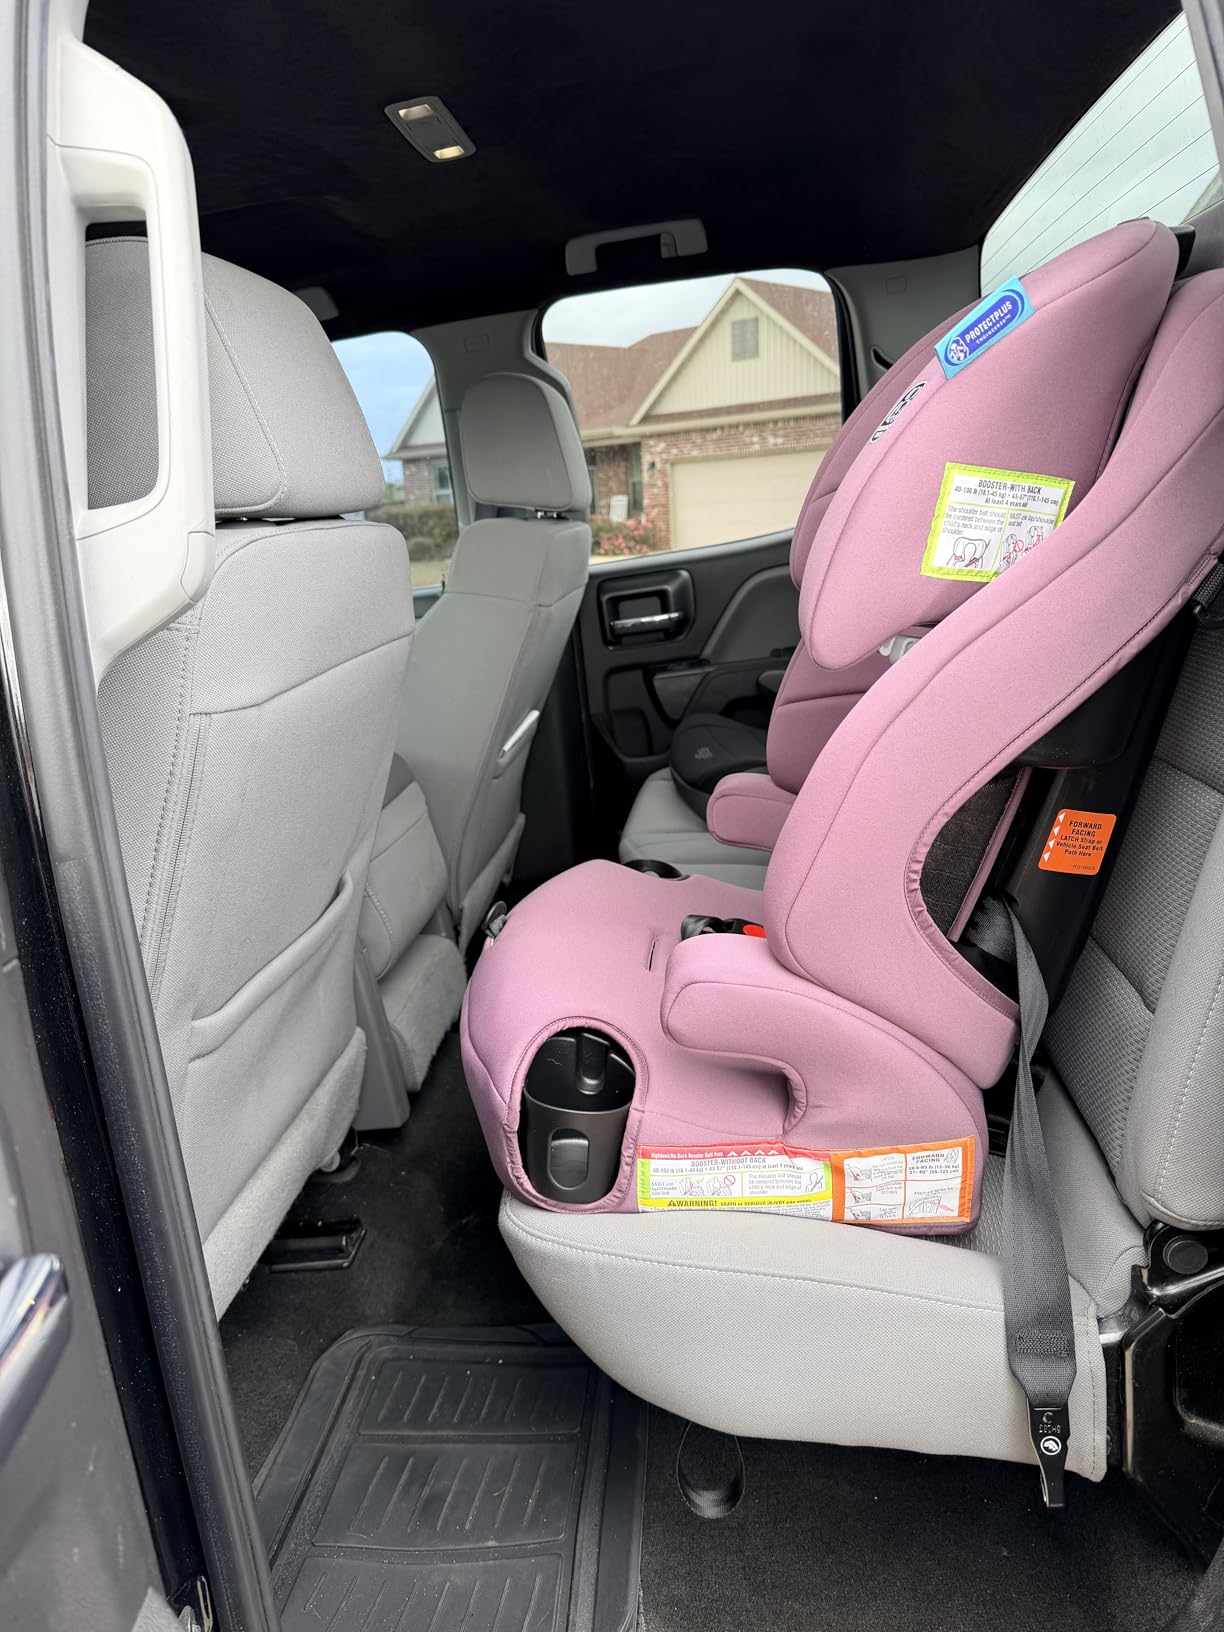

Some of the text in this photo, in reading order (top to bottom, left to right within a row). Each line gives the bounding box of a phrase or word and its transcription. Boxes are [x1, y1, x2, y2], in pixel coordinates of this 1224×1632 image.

[965, 301, 1012, 343] PROTECTPLUS
[978, 480, 1042, 494] BOOSTER-WITH BACK
[958, 506, 978, 515] shoulder
[1069, 821, 1102, 830] FORWARD
[1072, 829, 1096, 837] FACING
[691, 1157, 748, 1167] BOOSTER-WITHOUT
